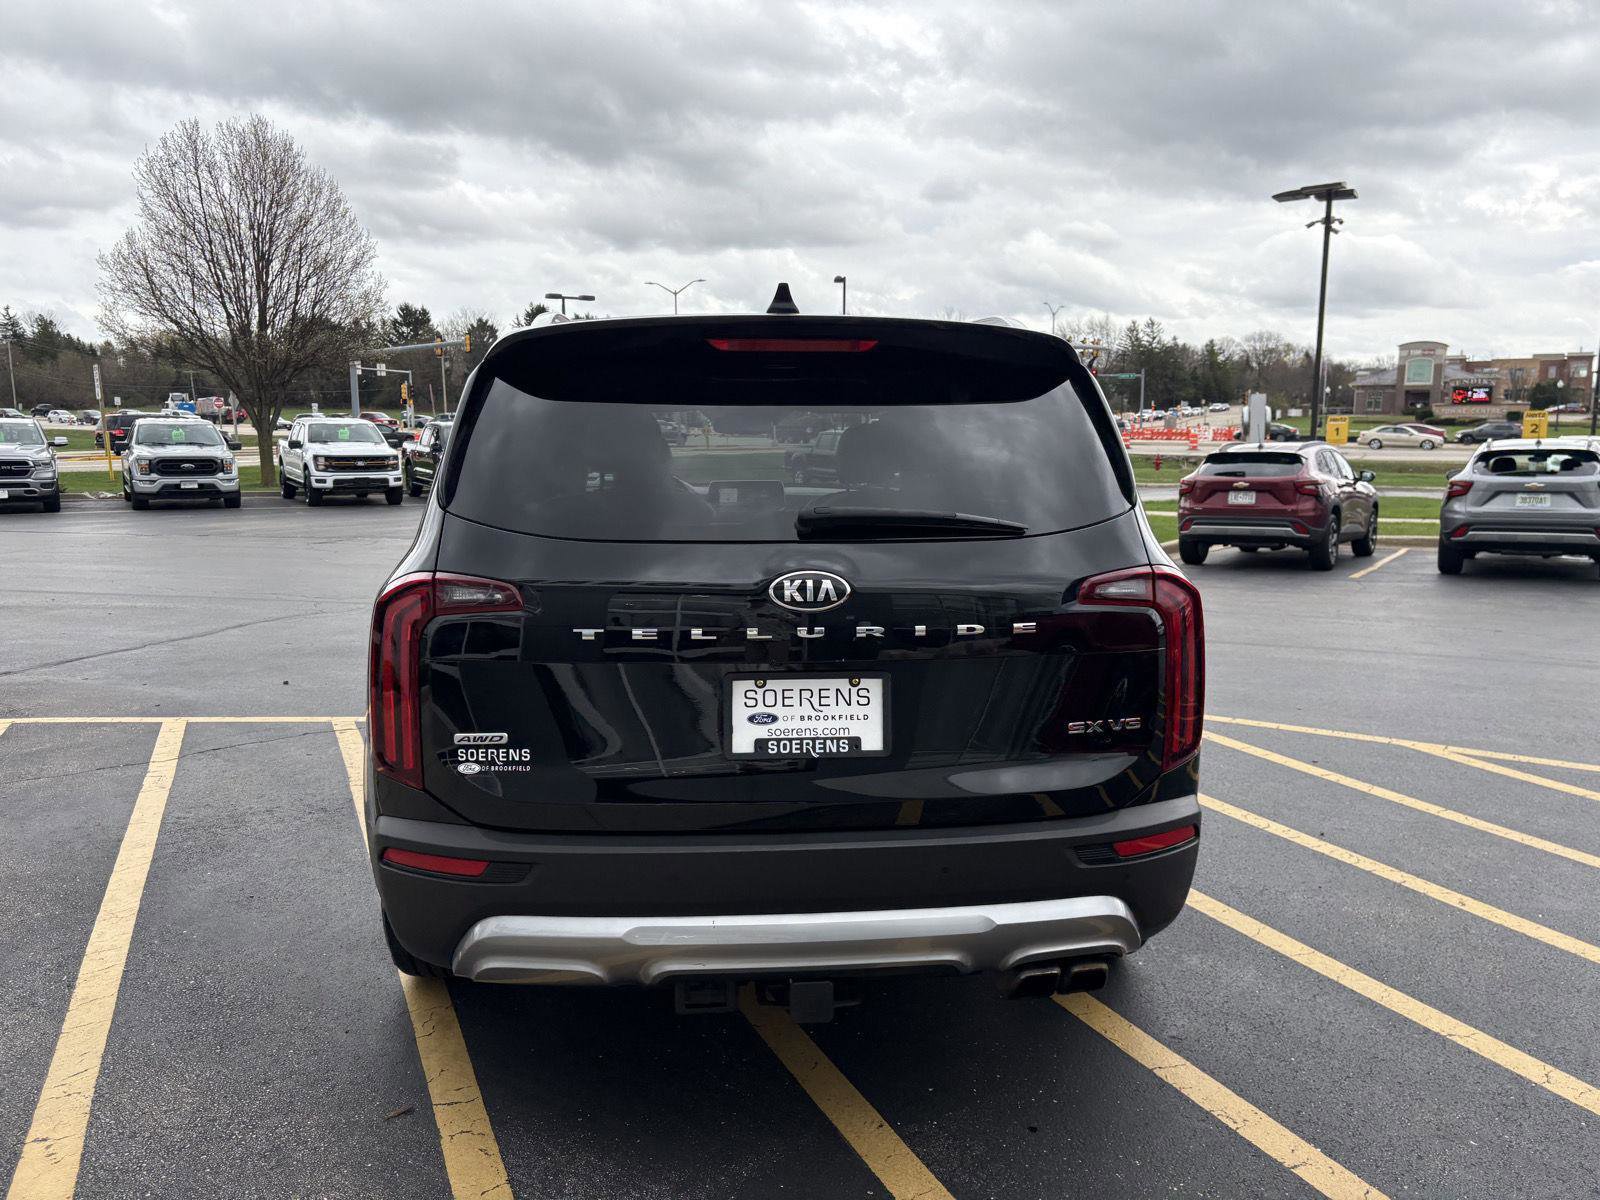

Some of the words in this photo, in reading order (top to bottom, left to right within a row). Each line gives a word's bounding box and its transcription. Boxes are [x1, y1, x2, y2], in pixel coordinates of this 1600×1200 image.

[1334, 427, 1339, 436] 1
[1530, 423, 1539, 433] 2
[783, 579, 838, 602] KIA
[572, 622, 1037, 640] TELLURIDE
[744, 687, 871, 713] SOERENS
[799, 714, 870, 722] BROOKFIELD
[457, 735, 504, 743] AWD
[766, 727, 851, 737] soerens.com
[767, 739, 849, 758] SOERENS
[457, 748, 531, 766] SOERENS
